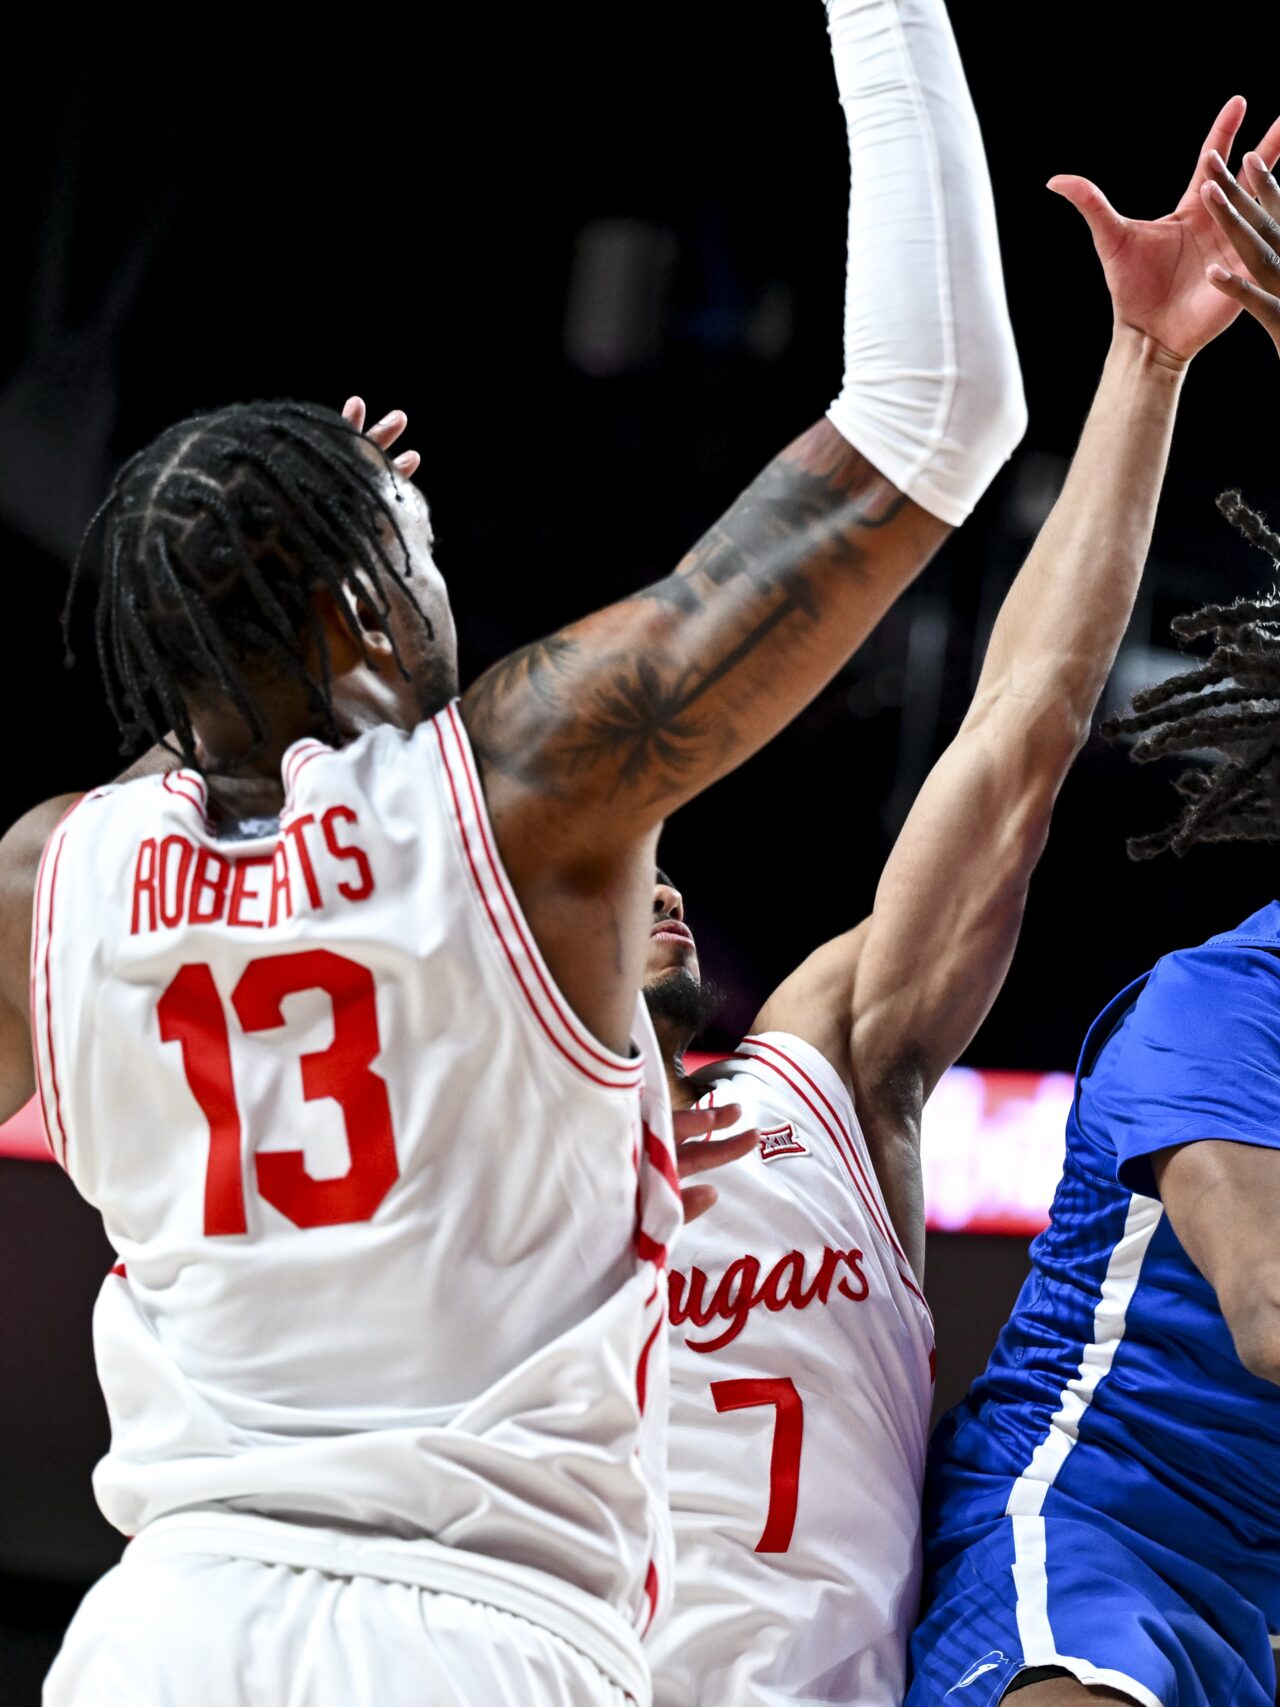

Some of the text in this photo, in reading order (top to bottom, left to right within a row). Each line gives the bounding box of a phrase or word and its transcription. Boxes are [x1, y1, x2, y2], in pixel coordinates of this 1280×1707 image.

[130, 804, 375, 935] ROBERTS
[156, 948, 400, 1237] 13
[667, 1245, 870, 1354] ugars
[710, 1377, 804, 1553] 7
